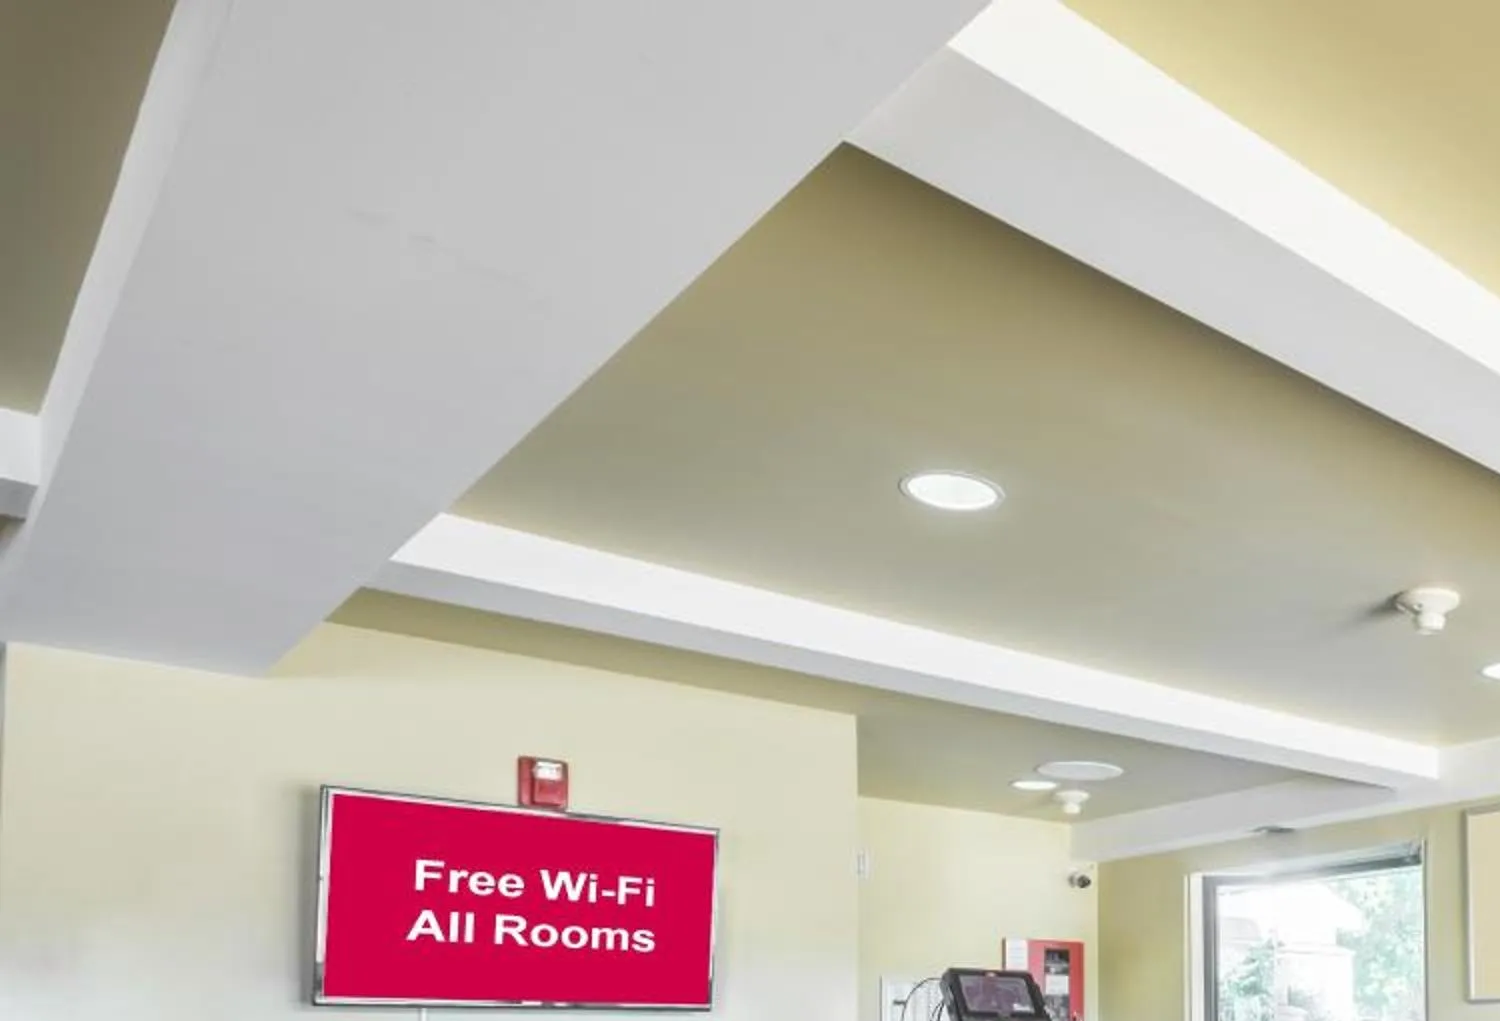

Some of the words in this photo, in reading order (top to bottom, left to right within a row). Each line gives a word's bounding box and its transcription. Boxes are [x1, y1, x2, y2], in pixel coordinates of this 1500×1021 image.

[415, 859, 525, 898] Free
[539, 869, 656, 907] Wi-Fi
[406, 909, 475, 944] All
[493, 913, 656, 953] Rooms
